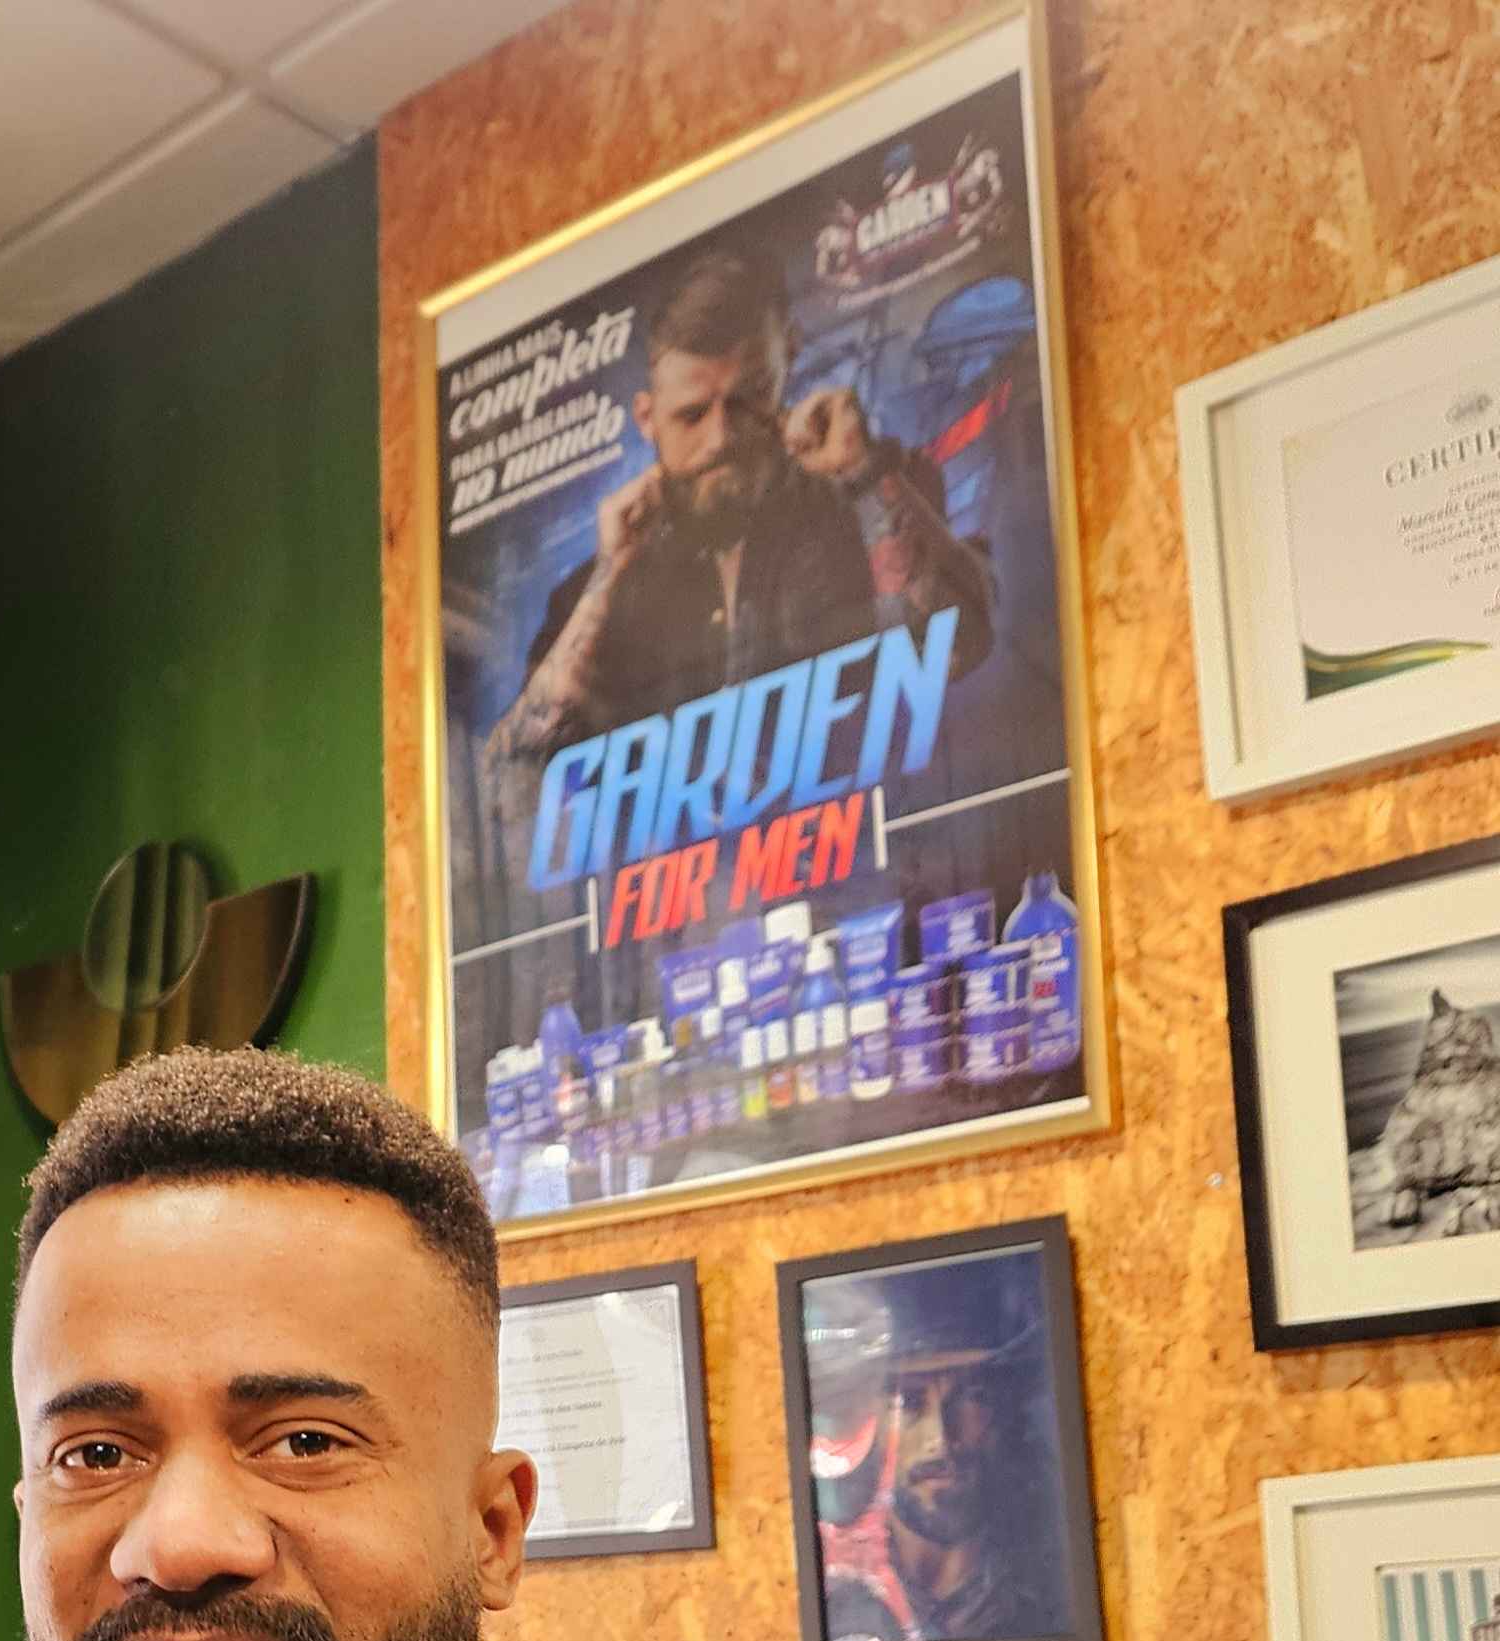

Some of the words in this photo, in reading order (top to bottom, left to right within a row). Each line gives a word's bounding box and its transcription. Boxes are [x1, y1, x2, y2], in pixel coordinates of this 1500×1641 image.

[450, 306, 637, 440] completa
[451, 467, 497, 513] no
[500, 394, 626, 491] mundo
[528, 606, 960, 891] GARDEN
[605, 838, 720, 950] FOR
[729, 792, 865, 912] MEN
